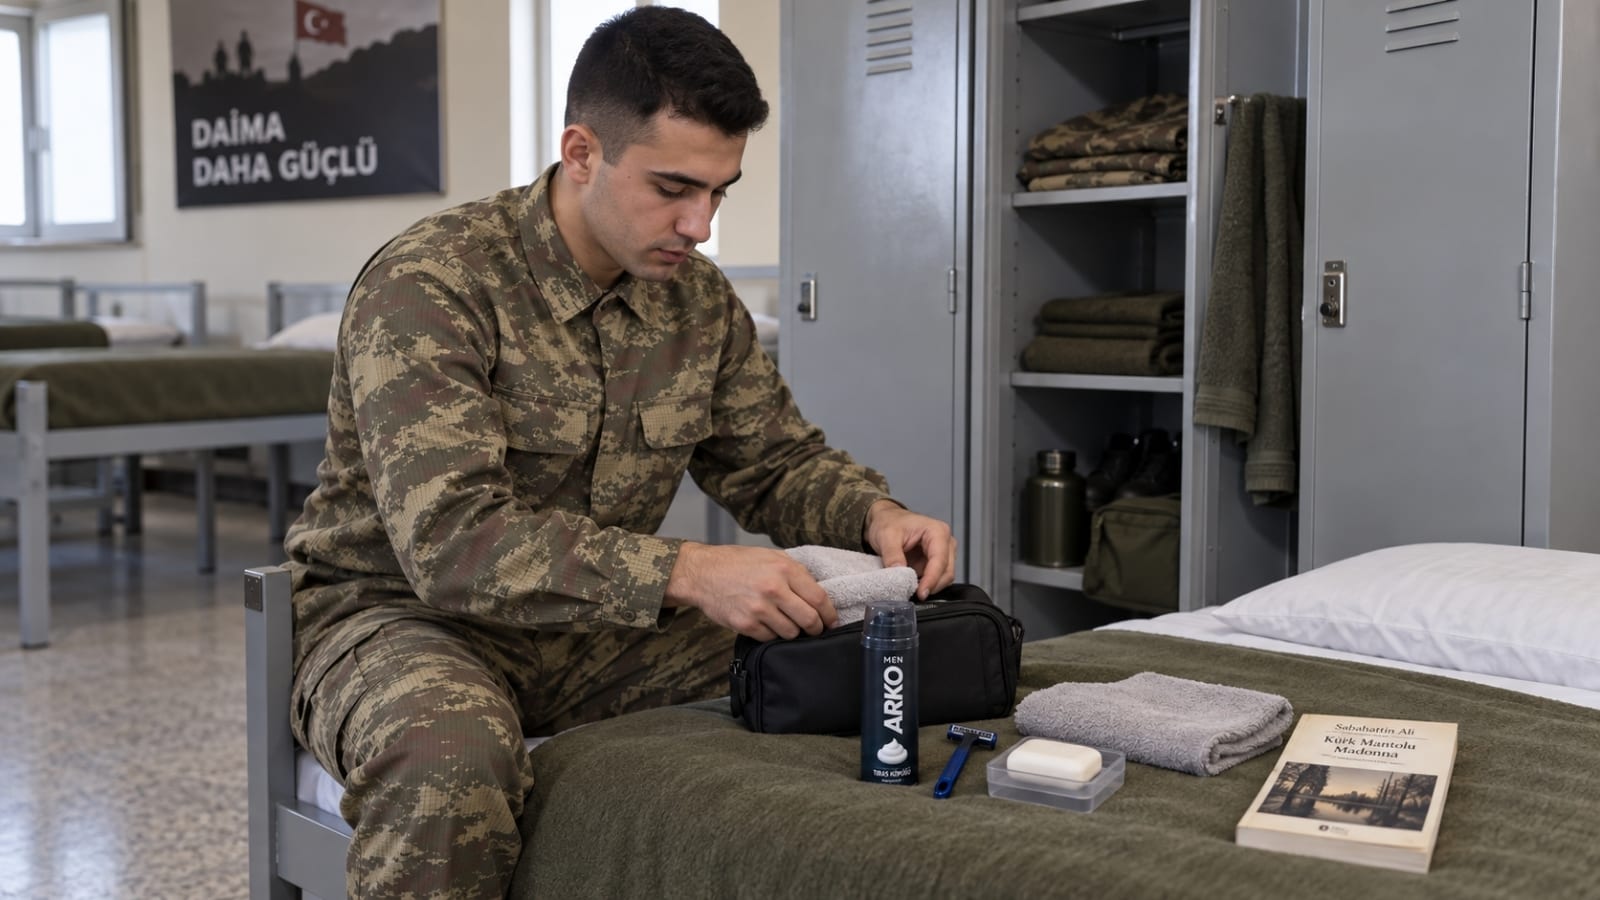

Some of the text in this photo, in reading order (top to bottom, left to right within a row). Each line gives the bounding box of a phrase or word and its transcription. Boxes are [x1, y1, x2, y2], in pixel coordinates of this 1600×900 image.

[191, 108, 286, 149] DAİMA
[193, 136, 378, 187] DAHA GÜÇLÜ
[883, 656, 904, 664] MEN
[883, 665, 904, 735] ARKO
[1335, 723, 1395, 734] Sabahattin
[1398, 727, 1416, 736] Ali
[1324, 736, 1417, 750] Kürk Mantolu
[1334, 746, 1398, 758] Madonna
